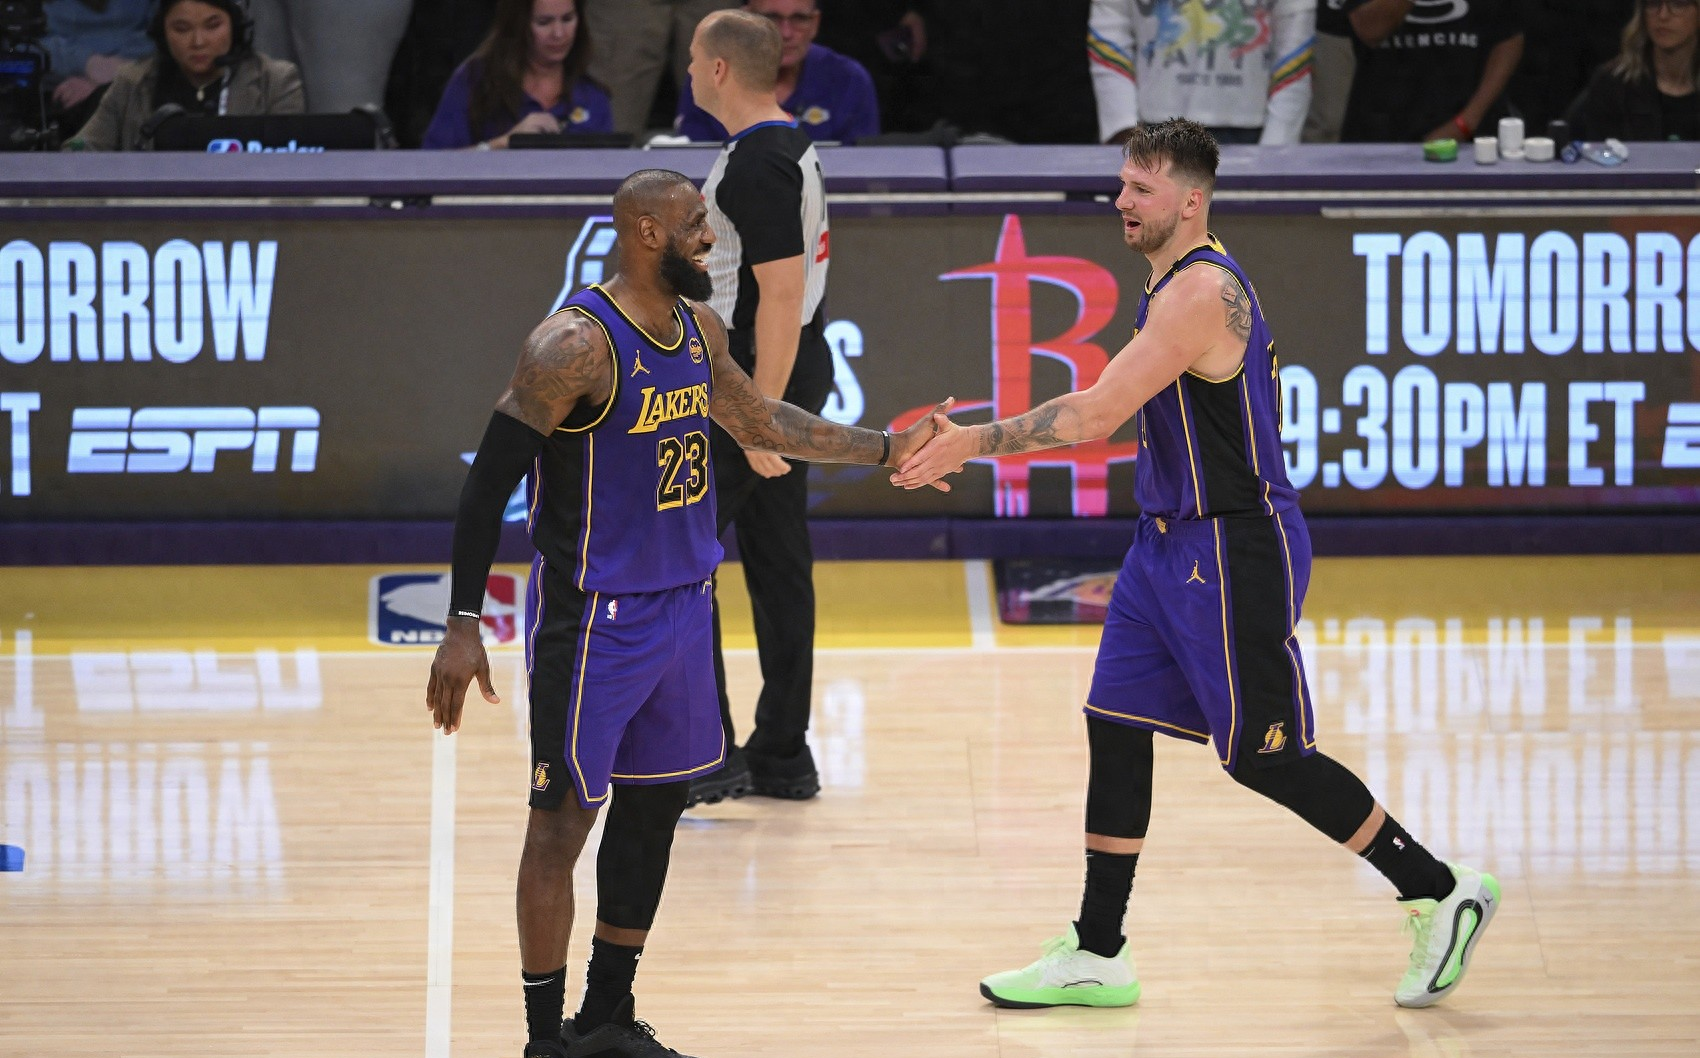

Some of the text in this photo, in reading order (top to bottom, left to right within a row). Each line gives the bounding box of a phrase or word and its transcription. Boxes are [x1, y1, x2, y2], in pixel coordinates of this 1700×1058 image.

[1352, 231, 1700, 355] TOMORR
[67, 406, 321, 473] ESPN
[627, 382, 709, 434] LAKERS
[1279, 365, 1546, 489] 9:30PM
[1568, 382, 1645, 486] ET
[656, 430, 709, 512] 23
